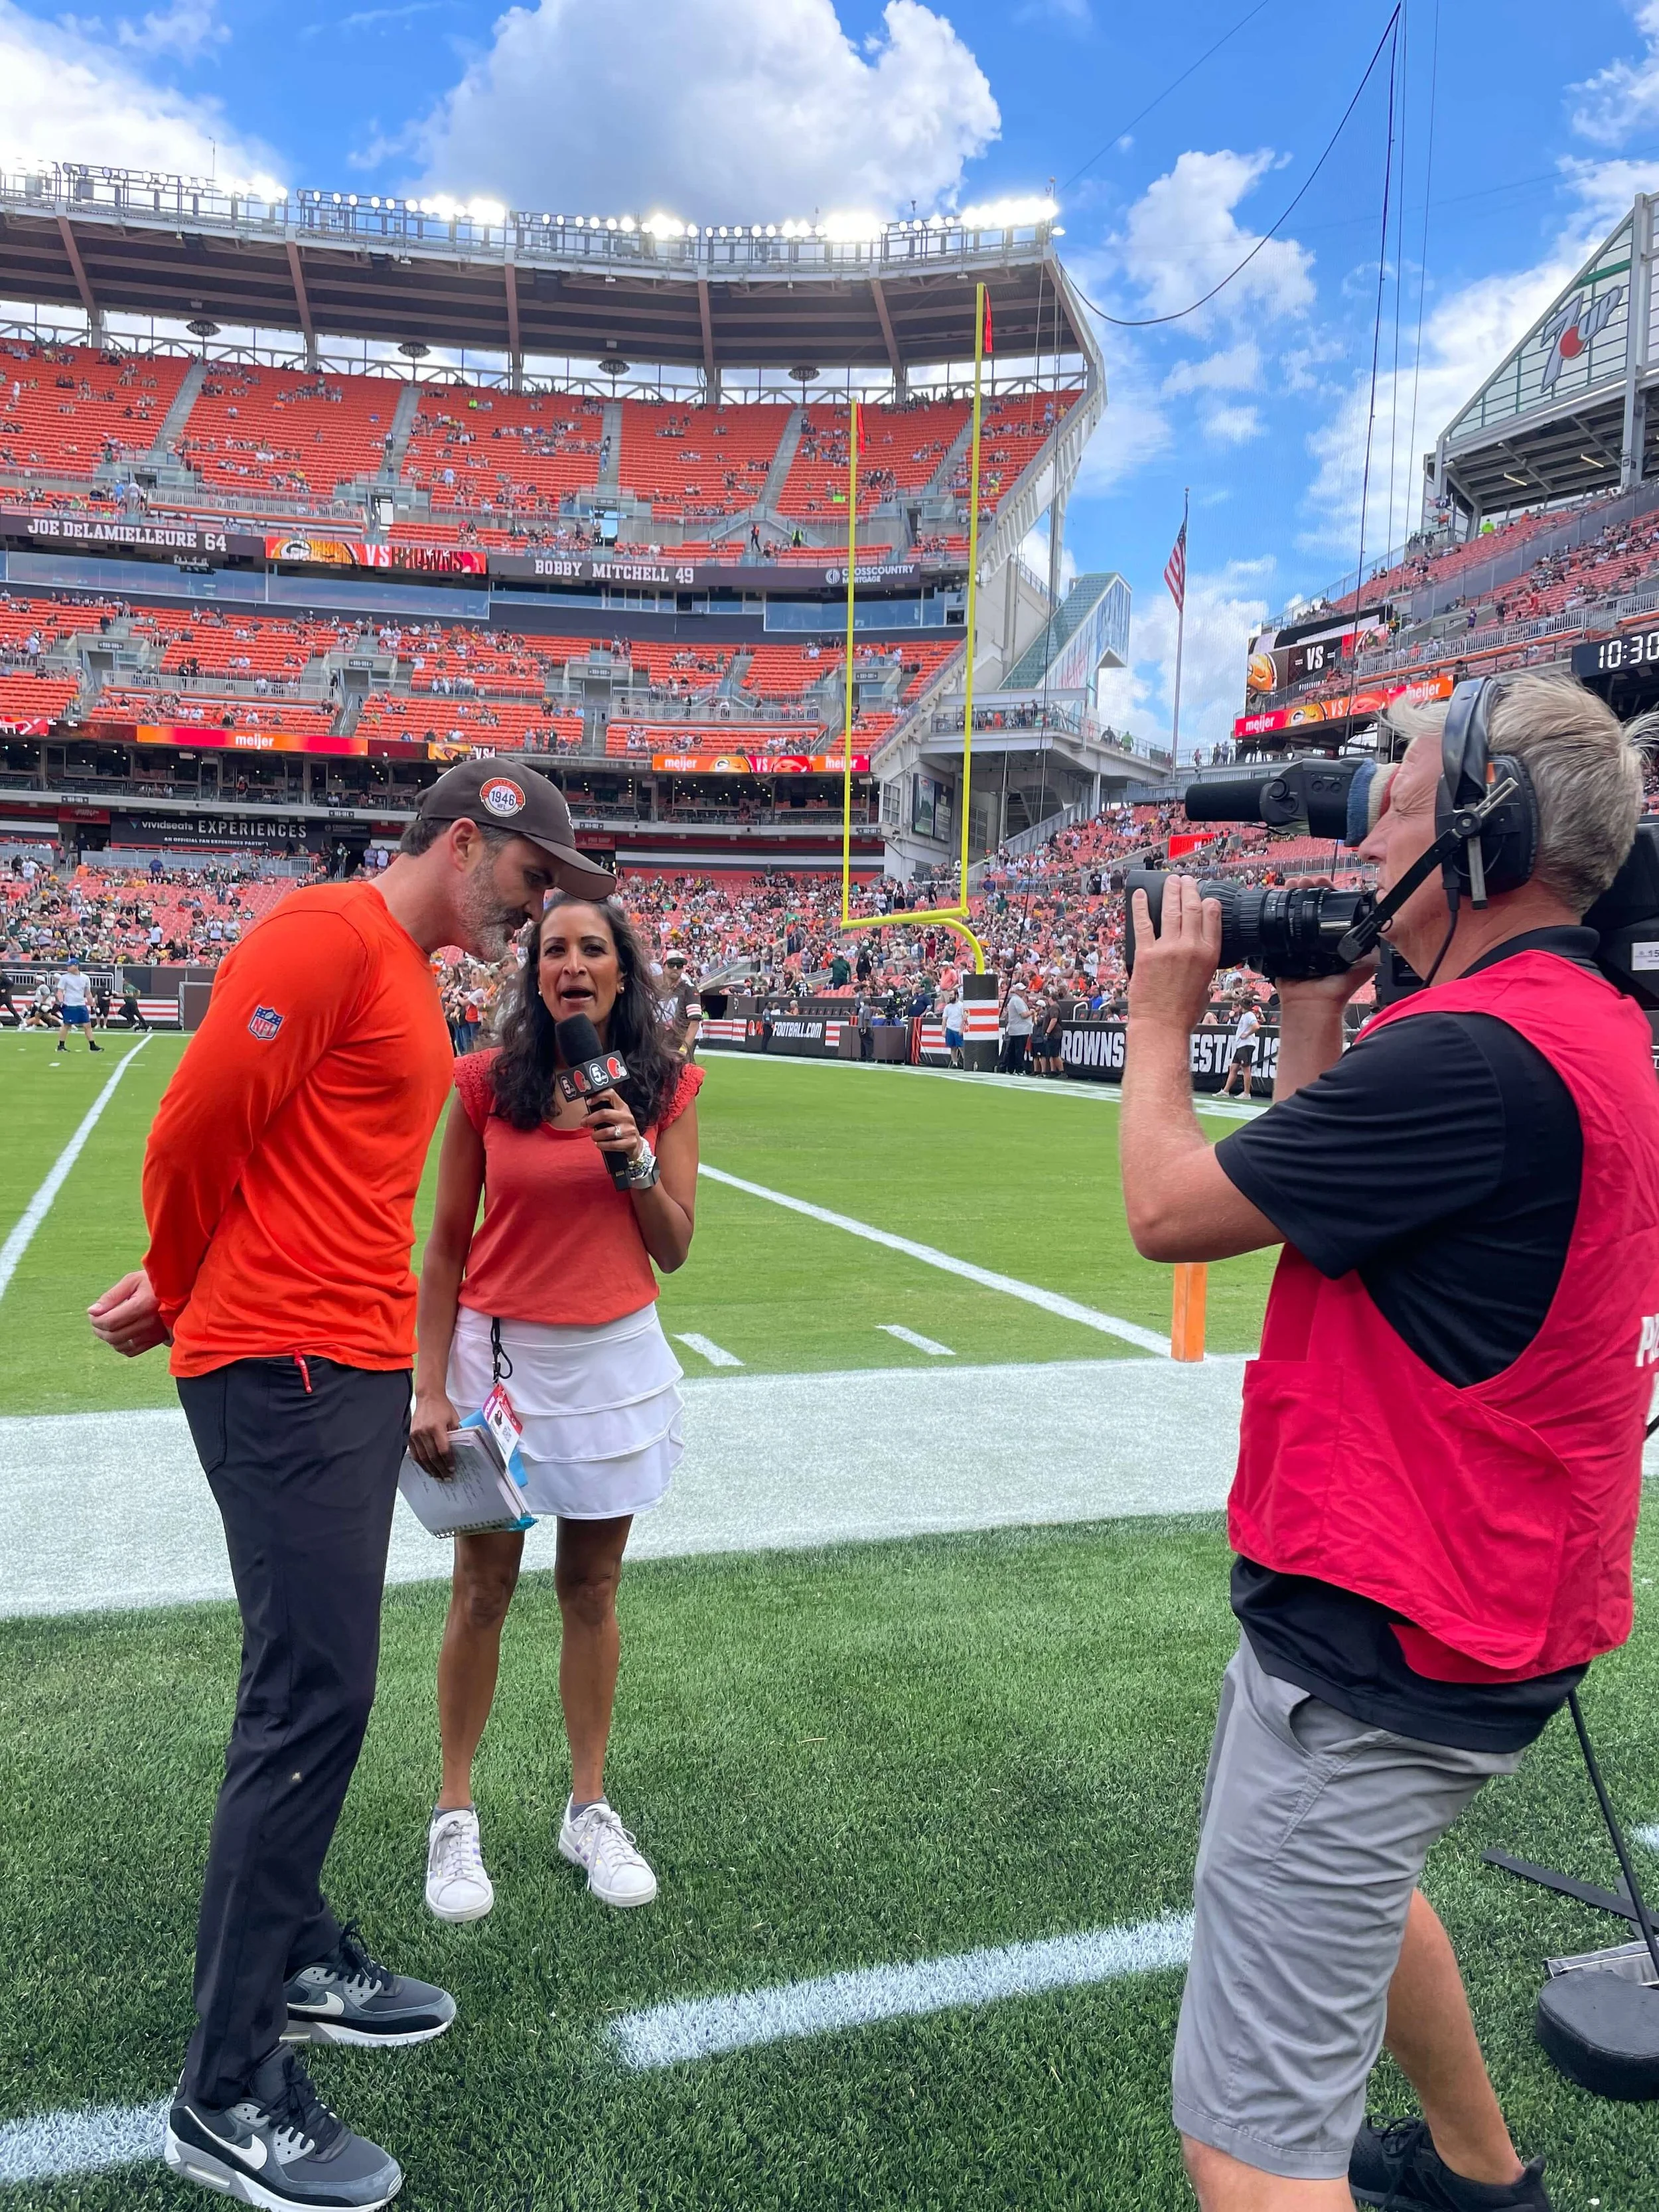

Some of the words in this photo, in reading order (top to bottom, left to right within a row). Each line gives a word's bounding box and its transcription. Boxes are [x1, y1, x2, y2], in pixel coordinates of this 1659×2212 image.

[28, 518, 60, 536] JOE
[204, 532, 227, 552] 64
[366, 544, 390, 567] VS
[535, 559, 582, 577] BOBBY
[593, 563, 669, 583] MITCHELL
[676, 567, 694, 583] 49
[842, 564, 914, 577] COSSCOUNTRY
[842, 575, 881, 584] MRTGAGE
[1307, 645, 1324, 671] VS
[1598, 631, 1659, 669] 10:30
[1245, 715, 1275, 734] meijer
[1331, 700, 1344, 717] VS
[235, 733, 275, 751] meijer
[664, 755, 697, 772] meijer
[757, 758, 768, 771] VS
[491, 790, 515, 806] 1946
[141, 820, 194, 831] vividseats
[198, 820, 307, 838] EXPERIENCES
[252, 1017, 276, 1037] NFL
[1061, 1029, 1125, 1068] ROWNS
[591, 1066, 603, 1082] 5
